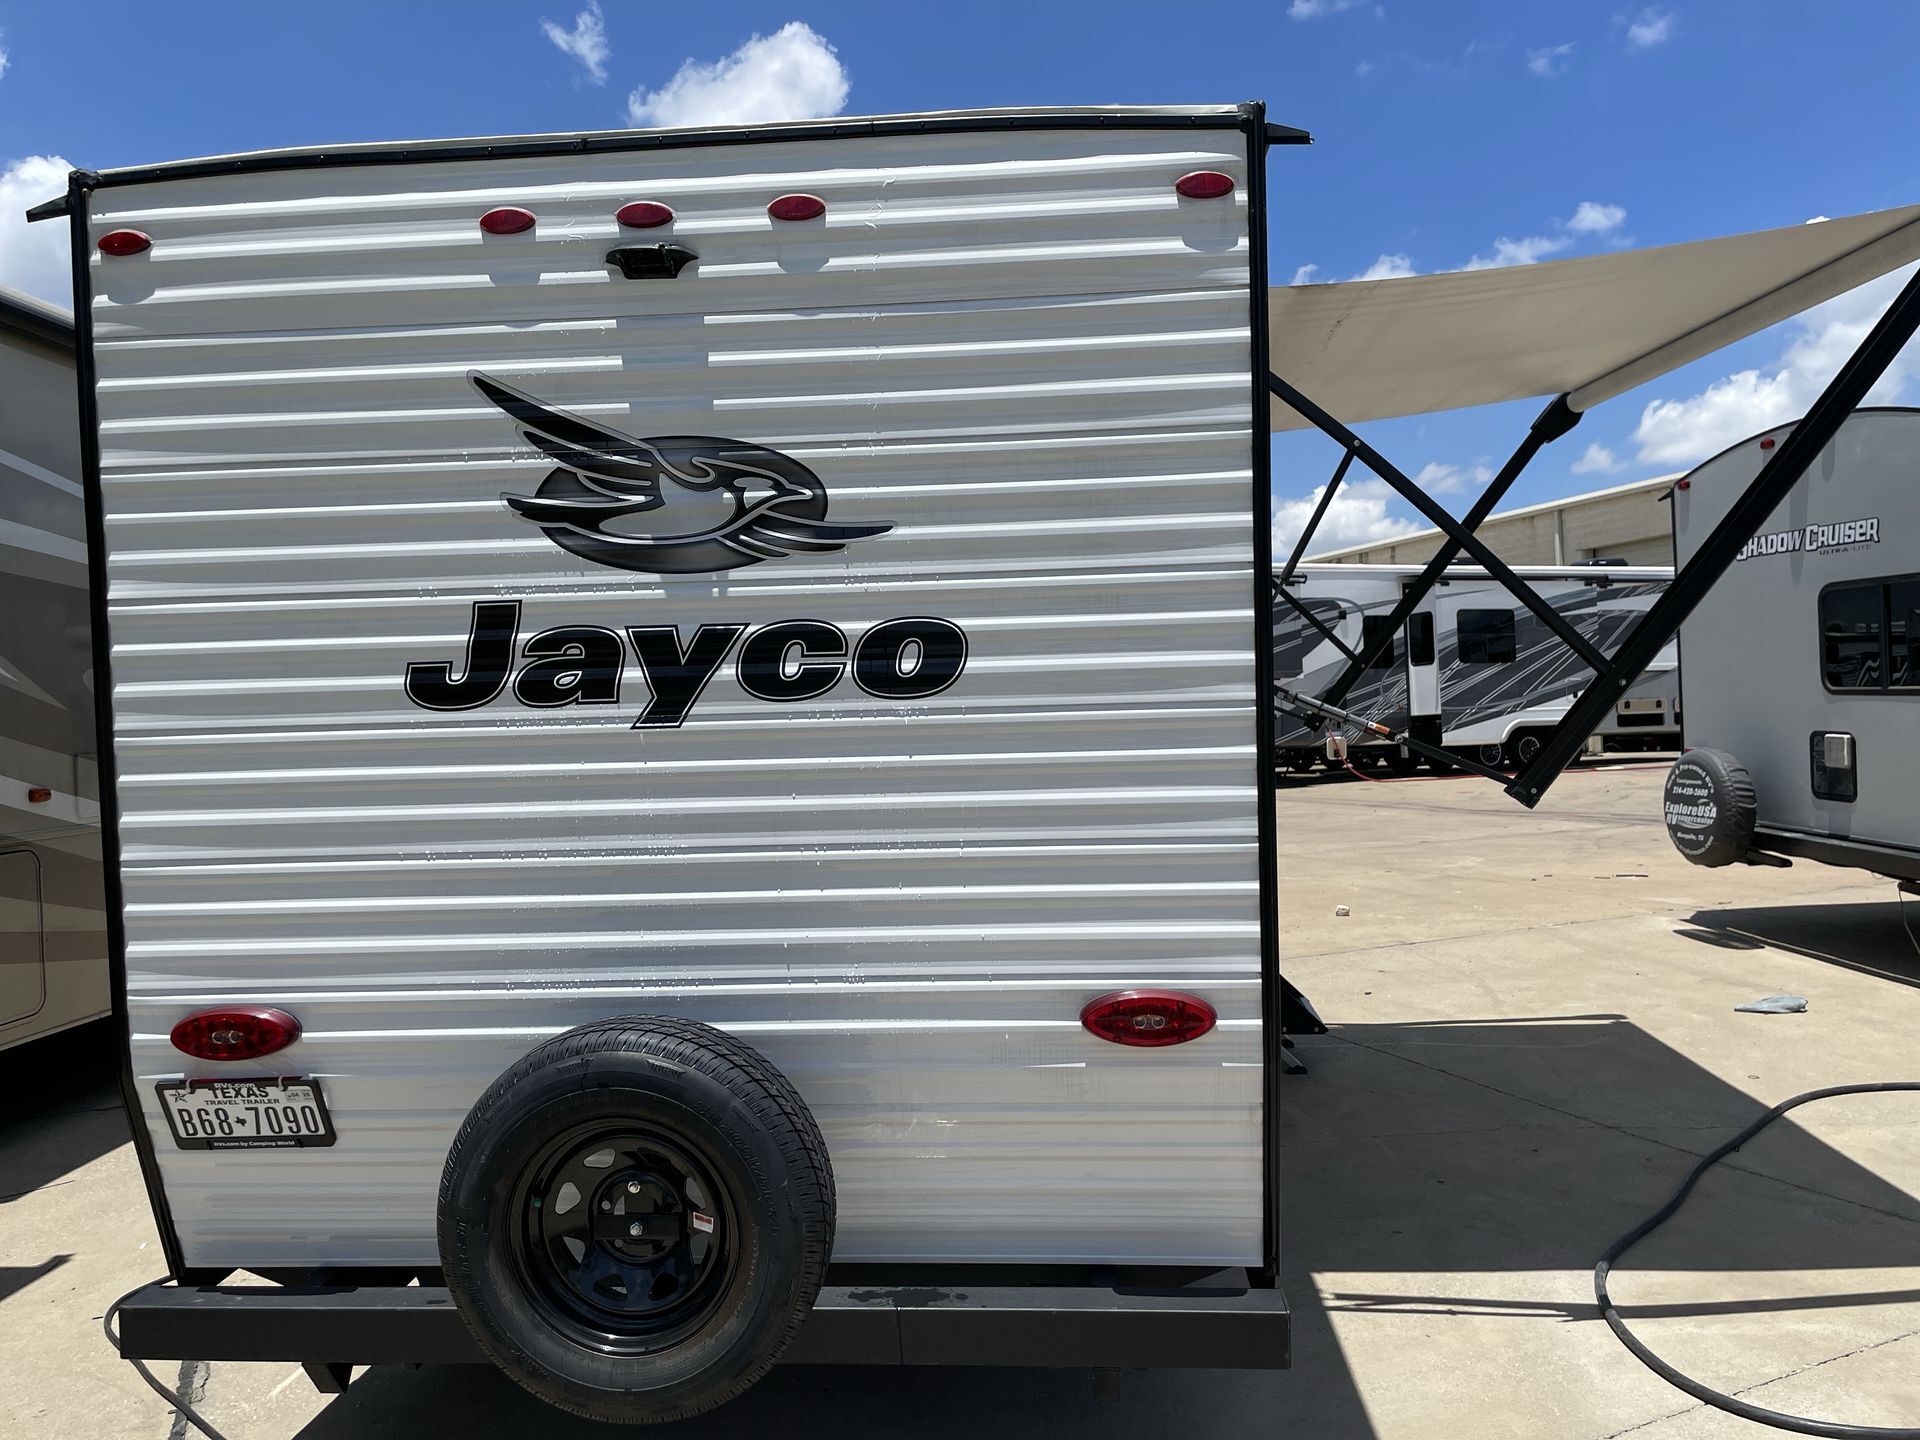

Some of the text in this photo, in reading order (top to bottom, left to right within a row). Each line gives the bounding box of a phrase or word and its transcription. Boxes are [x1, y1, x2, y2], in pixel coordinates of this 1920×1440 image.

[1804, 517, 1880, 551] CRUISER
[404, 600, 969, 729] Jayco
[1665, 801, 1718, 818] ExploreUSA
[1666, 813, 1678, 825] RV
[208, 1086, 270, 1099] TEXAS
[177, 1105, 320, 1137] B68 7090
